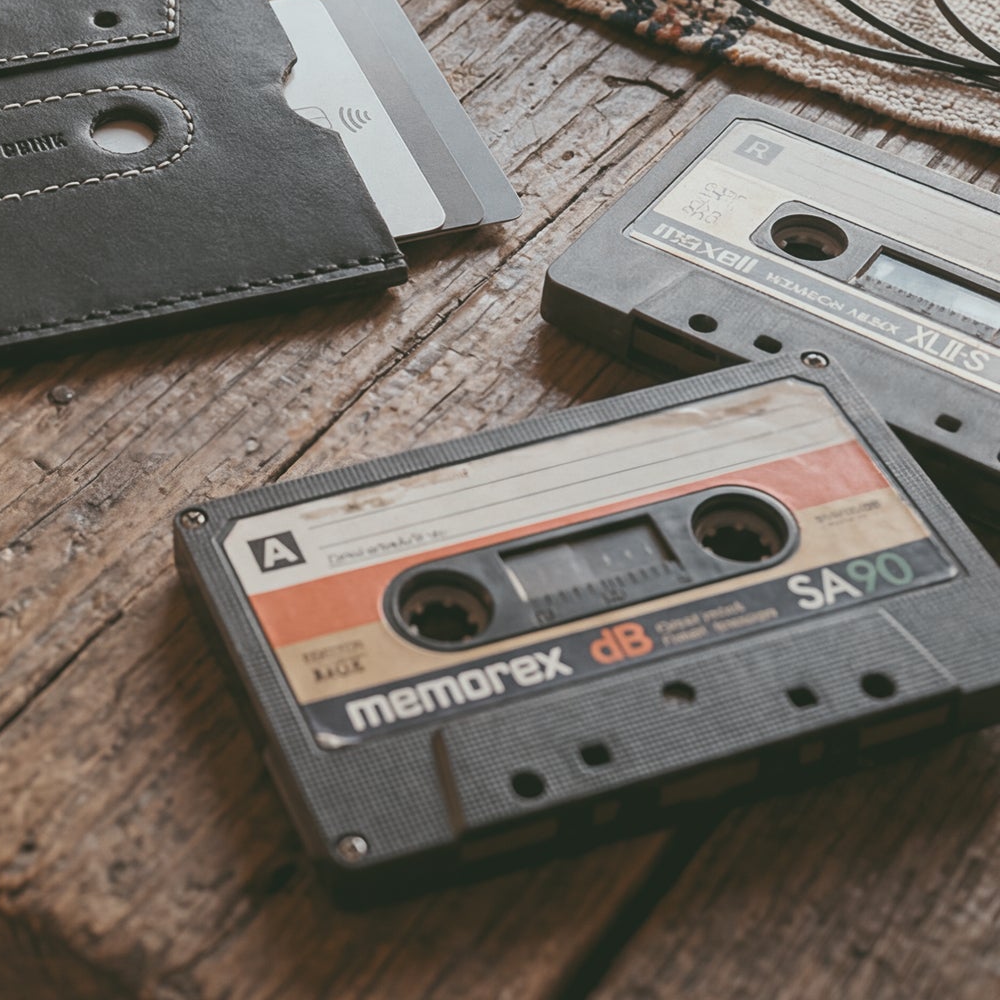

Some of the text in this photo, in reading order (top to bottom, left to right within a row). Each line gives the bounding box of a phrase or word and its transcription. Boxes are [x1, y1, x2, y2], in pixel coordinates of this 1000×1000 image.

[745, 140, 770, 160] R
[263, 537, 299, 569] A
[345, 646, 574, 732] memorex
[590, 622, 654, 664] dB
[787, 552, 914, 610] SA90
